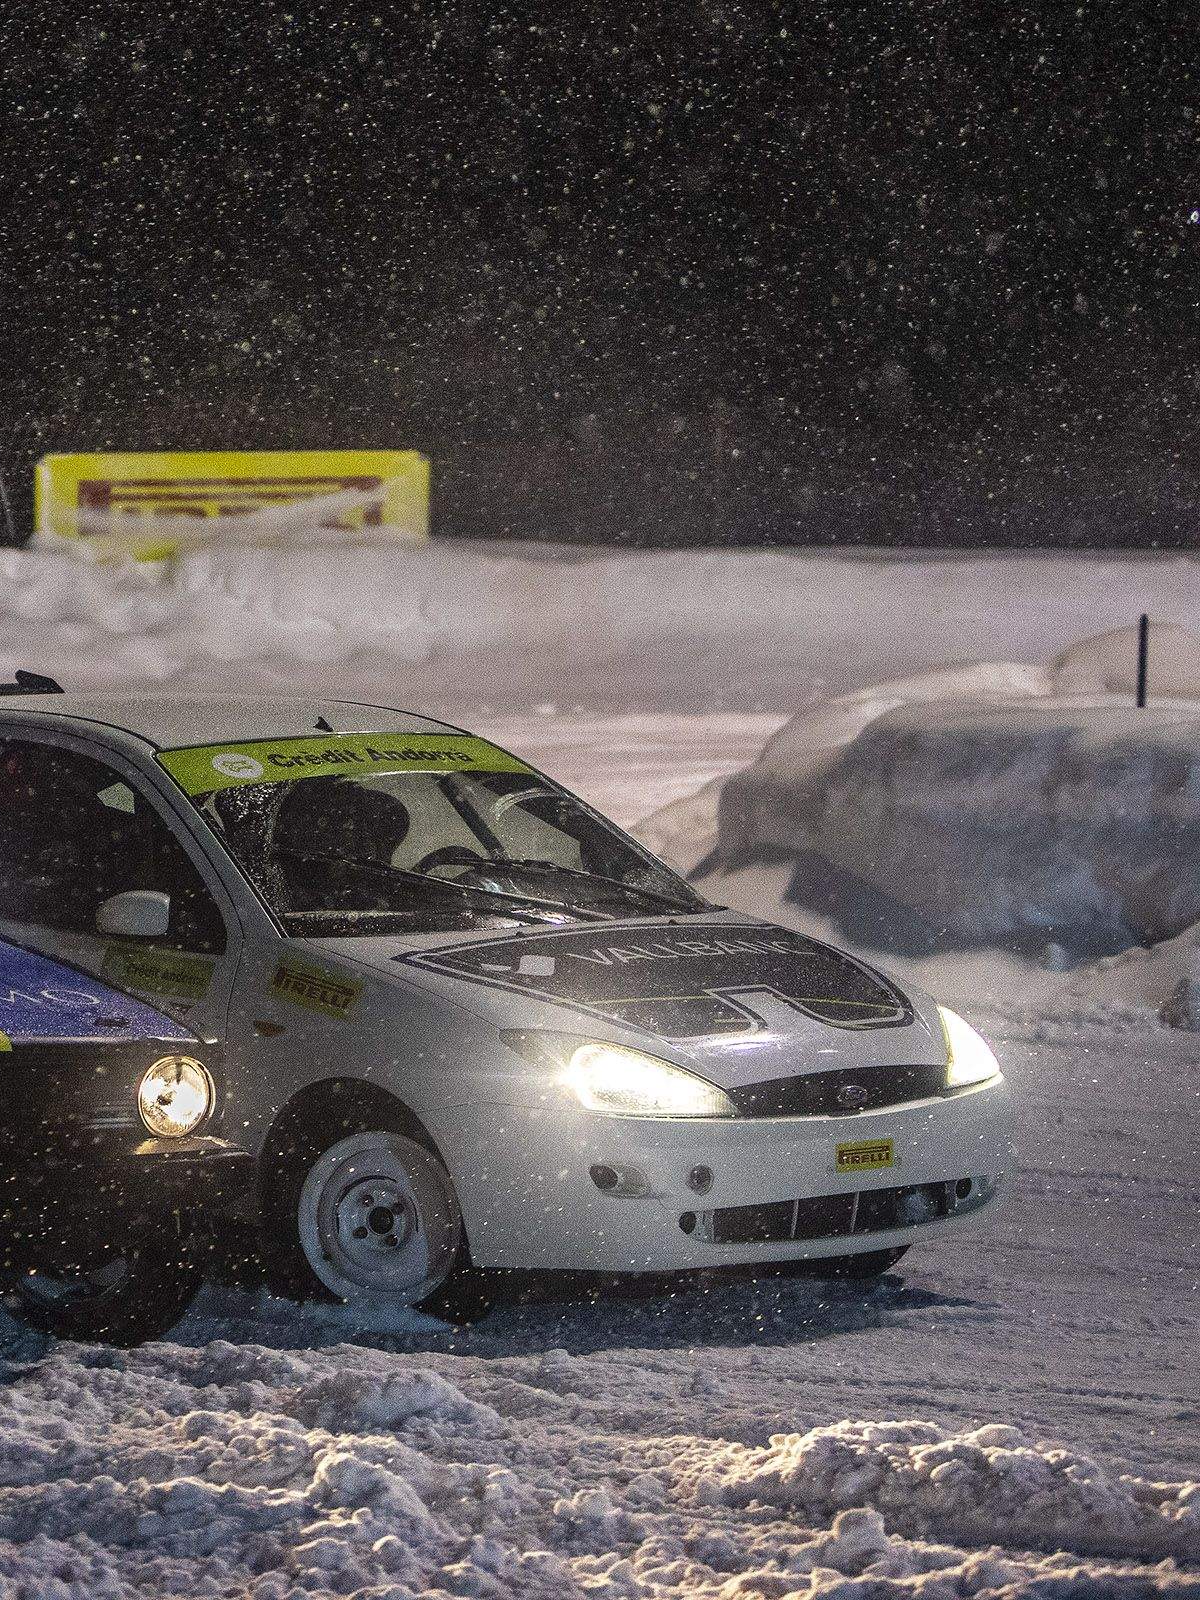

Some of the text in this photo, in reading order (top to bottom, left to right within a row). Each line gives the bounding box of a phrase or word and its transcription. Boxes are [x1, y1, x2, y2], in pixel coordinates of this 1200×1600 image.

[565, 940, 818, 965] VALLBANC
[273, 966, 355, 1008] PIRELLI
[838, 1145, 890, 1166] PIRELLI
